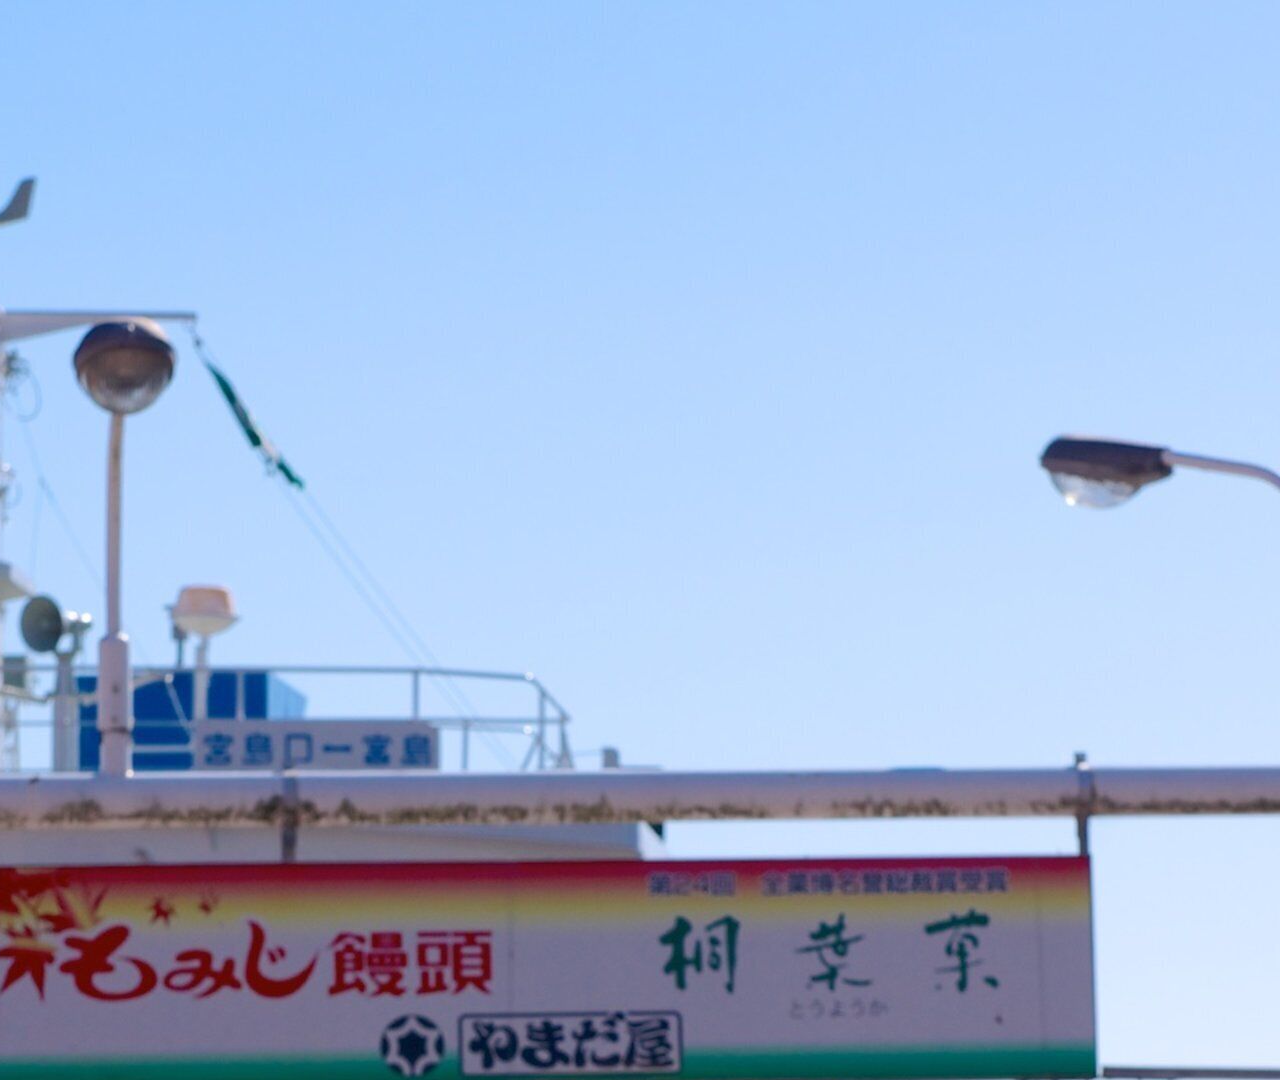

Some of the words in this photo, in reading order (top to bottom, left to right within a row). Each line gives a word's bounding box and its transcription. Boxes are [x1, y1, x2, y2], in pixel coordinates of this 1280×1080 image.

[60, 920, 493, 1001] もみじ饅頭
[658, 910, 999, 994] 桐葉菓
[469, 1012, 675, 1070] やまだ屋
